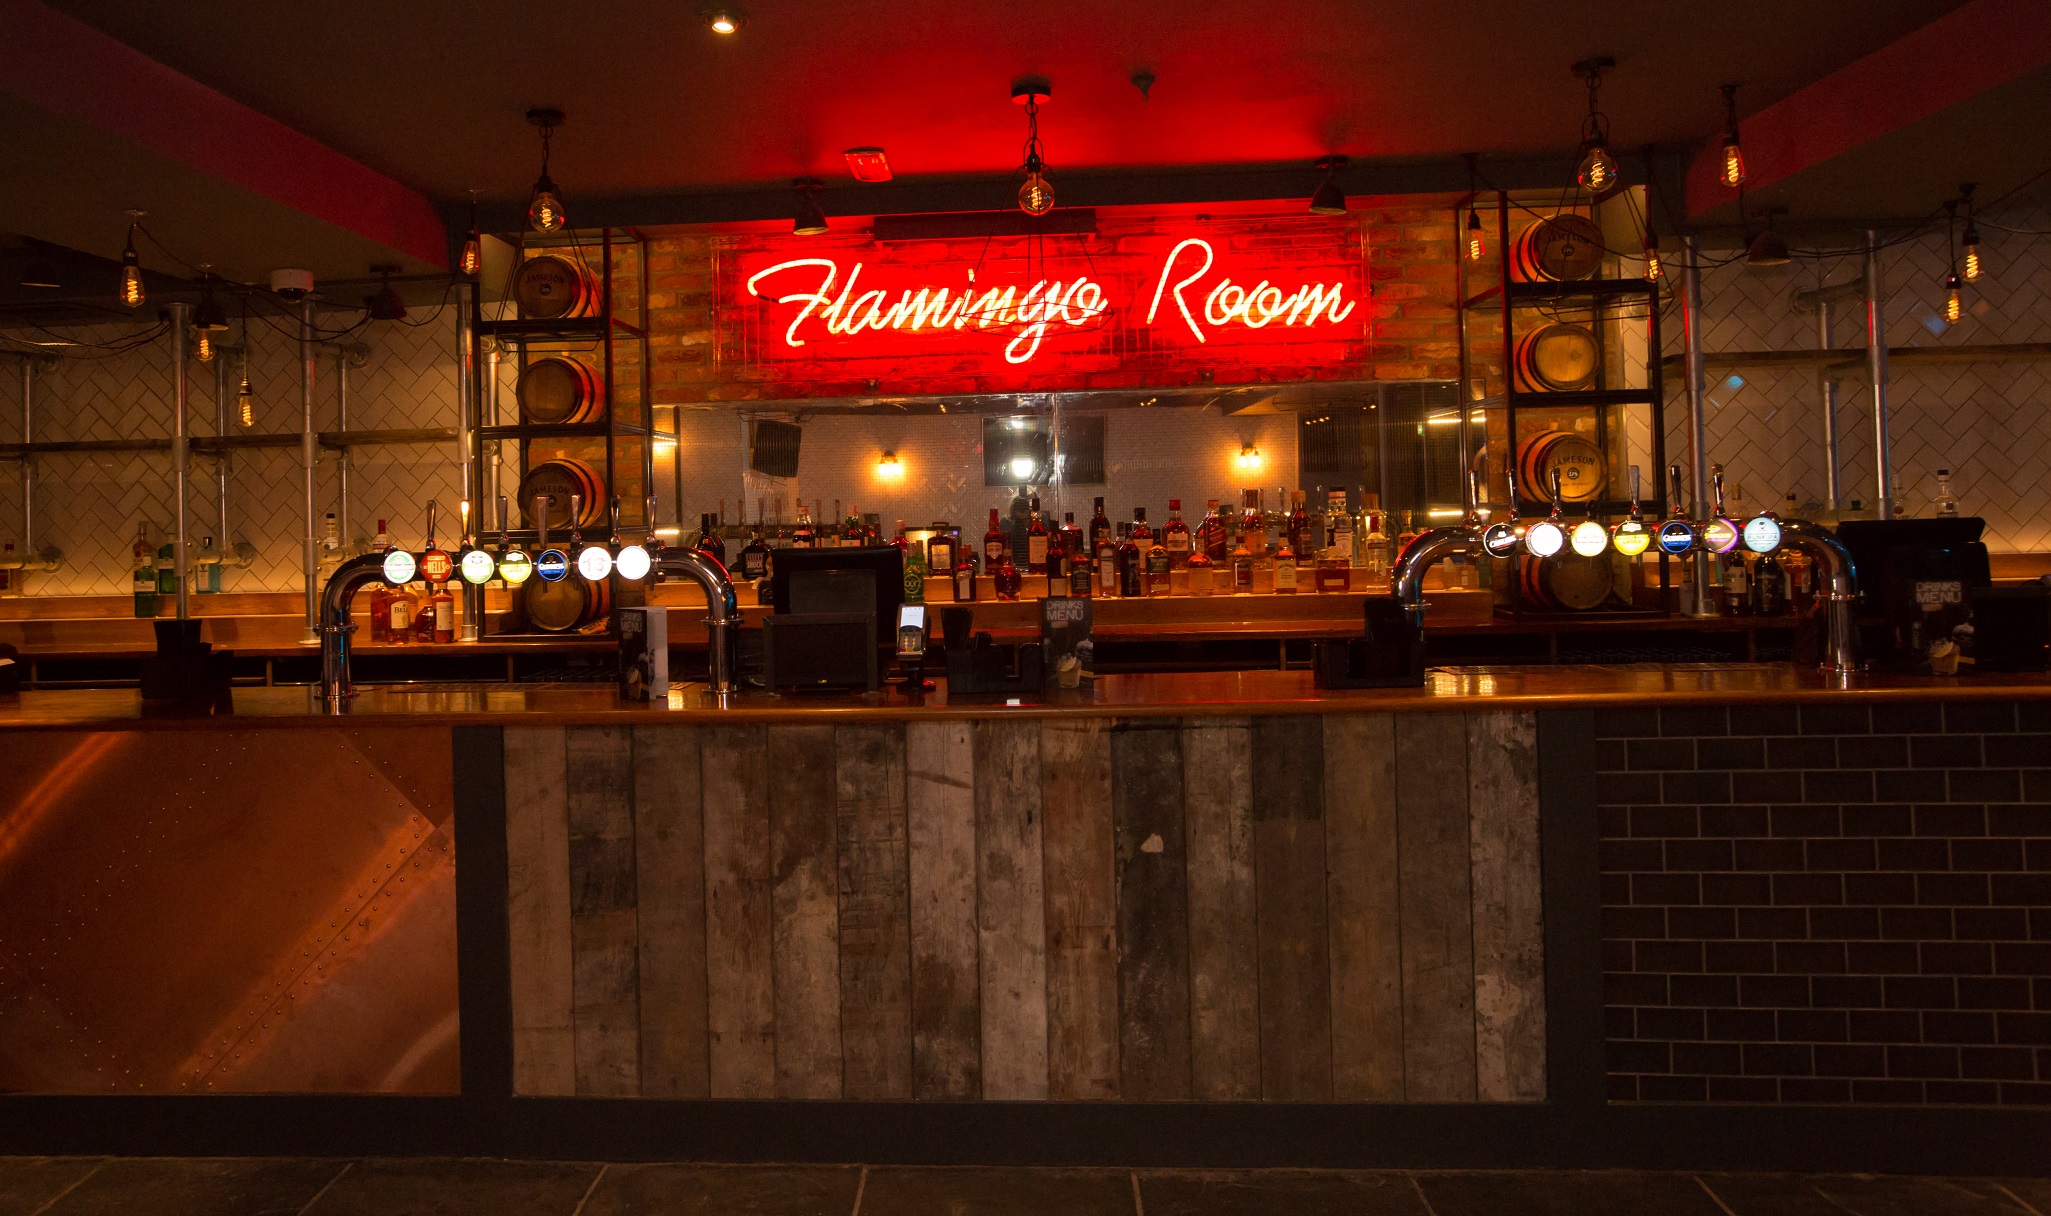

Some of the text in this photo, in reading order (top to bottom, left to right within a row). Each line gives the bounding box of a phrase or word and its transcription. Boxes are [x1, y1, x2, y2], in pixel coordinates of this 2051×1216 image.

[525, 273, 566, 284] JAMESON
[747, 237, 1356, 364] Flamingo Room
[1552, 455, 1595, 467] JAMESON
[529, 485, 569, 496] JAMESON
[427, 561, 446, 574] HELLS
[1916, 581, 1962, 592] DRINKS
[1916, 591, 1962, 603] MENU
[1046, 600, 1084, 610] DRINKS
[1046, 610, 1084, 621] MENU
